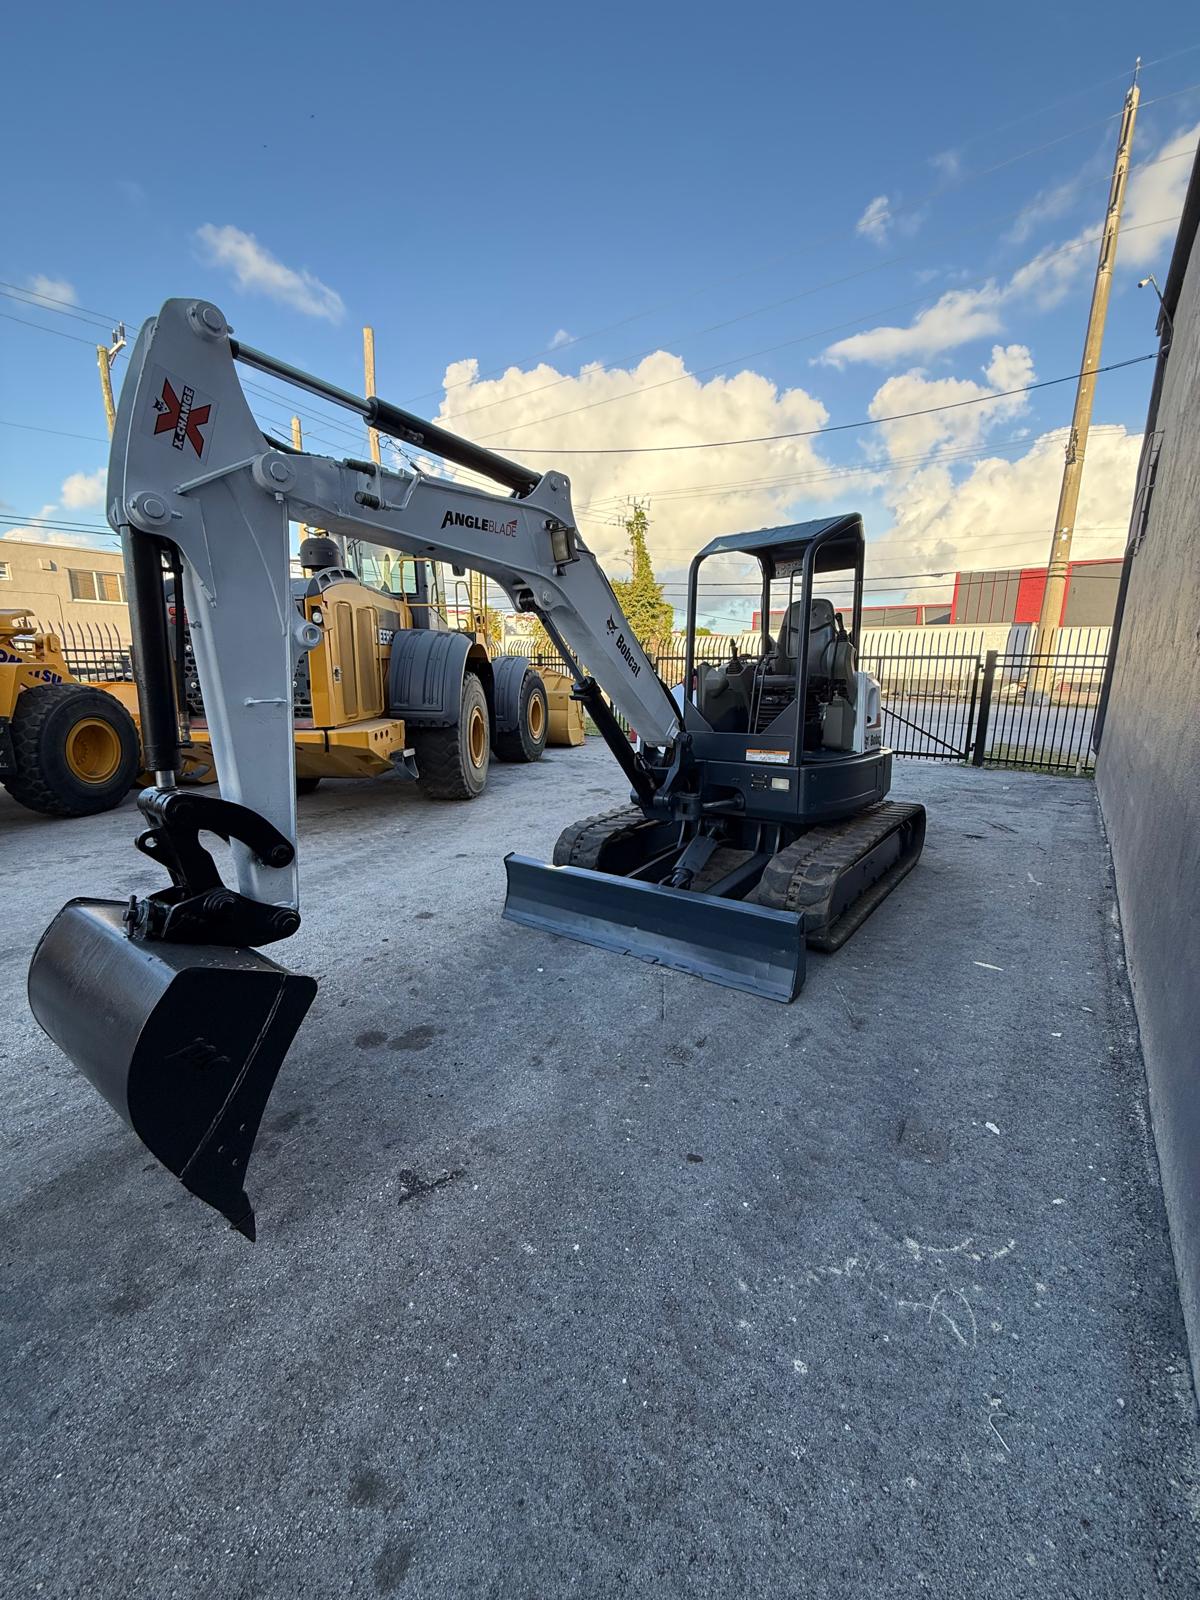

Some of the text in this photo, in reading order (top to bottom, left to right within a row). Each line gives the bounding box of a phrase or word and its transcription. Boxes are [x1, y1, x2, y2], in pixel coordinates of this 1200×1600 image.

[174, 387, 194, 449] X-CHANGE
[440, 510, 518, 538] ANGLEBLADE
[616, 634, 641, 678] Bobcat
